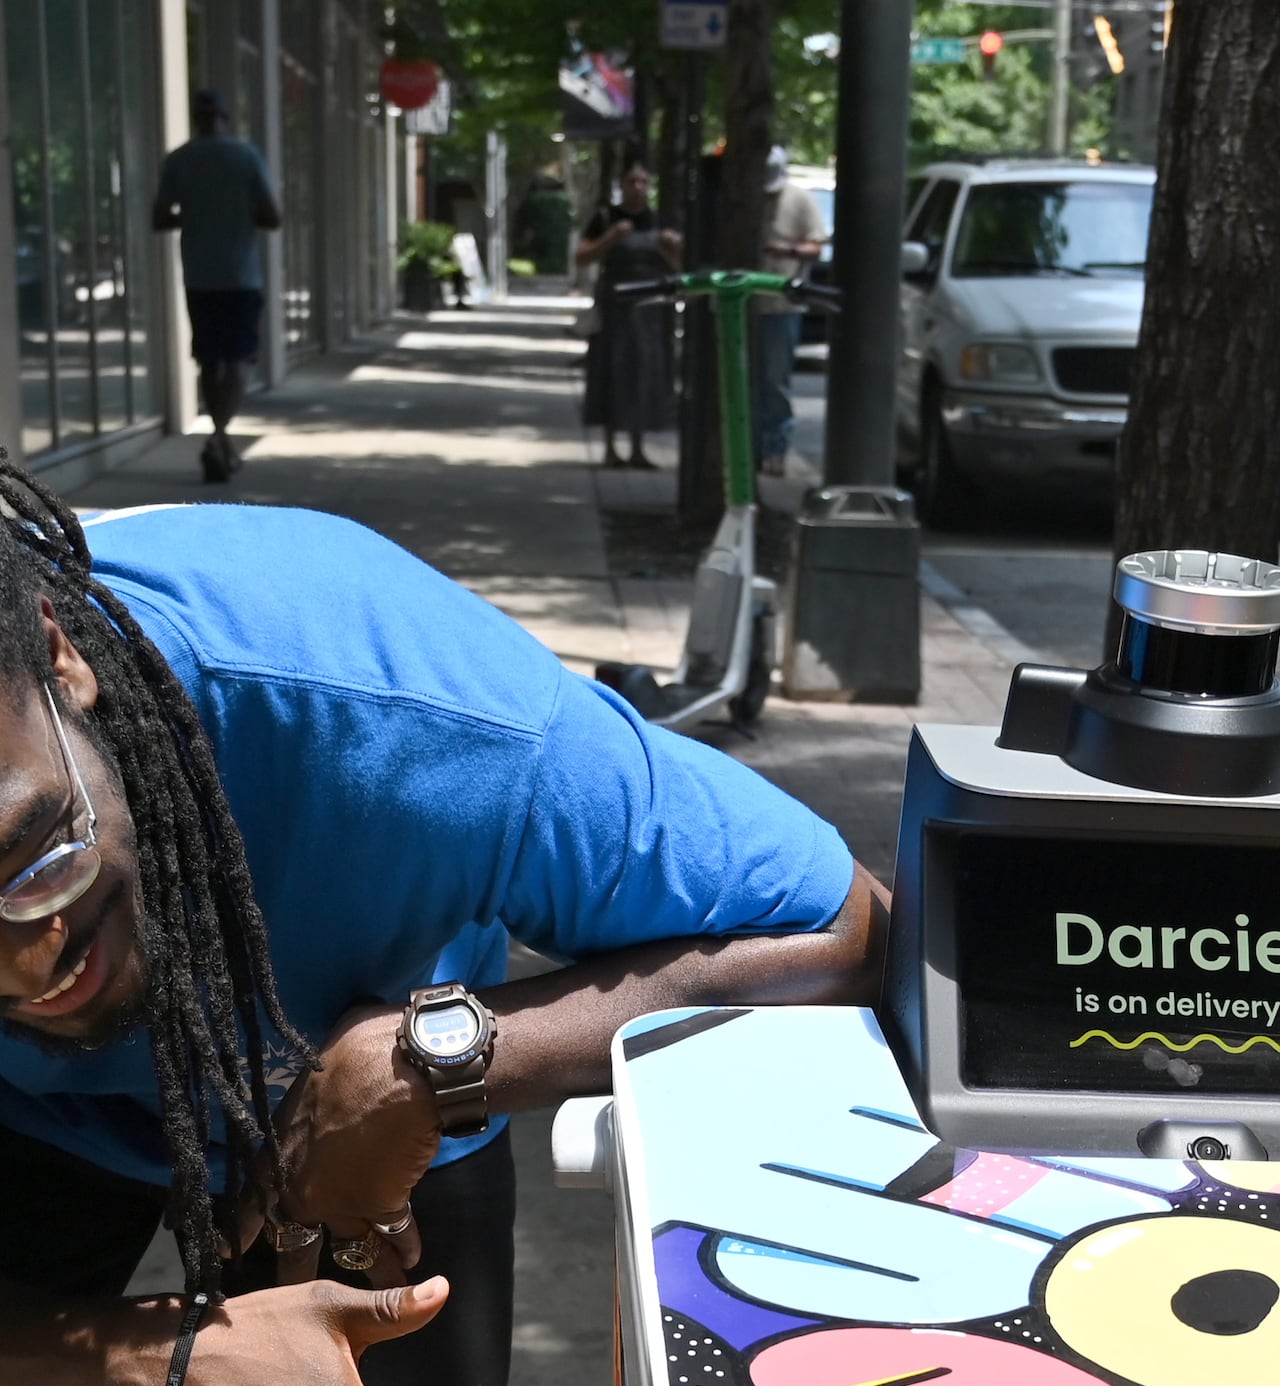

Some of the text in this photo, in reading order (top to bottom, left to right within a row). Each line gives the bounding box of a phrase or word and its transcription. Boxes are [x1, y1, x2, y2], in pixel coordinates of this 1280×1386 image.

[1075, 987, 1280, 1027] is on delivery
